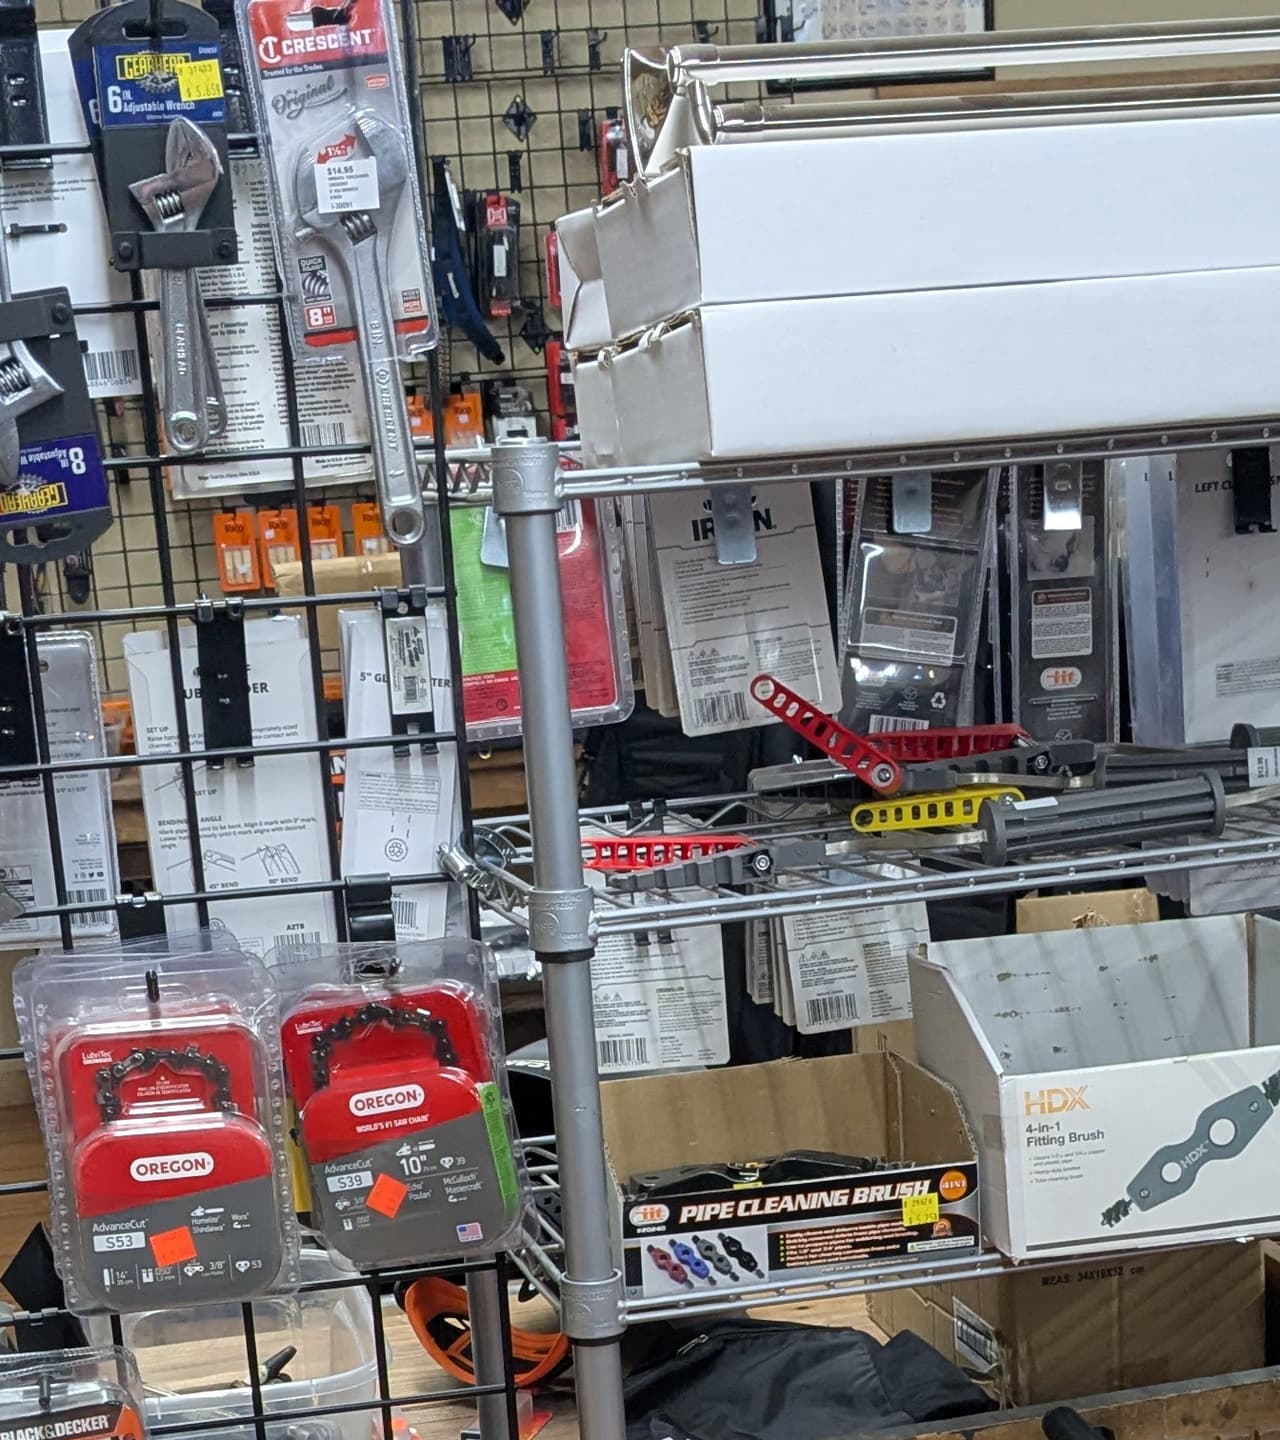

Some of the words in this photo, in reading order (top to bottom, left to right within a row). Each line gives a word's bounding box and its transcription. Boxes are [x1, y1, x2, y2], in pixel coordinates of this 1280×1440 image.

[281, 29, 372, 56] CRESCENT
[124, 55, 186, 79] GEARHEAD
[108, 85, 122, 113] 6
[123, 101, 165, 113] Adjustable
[165, 99, 196, 110] Wrench
[271, 75, 336, 120] Original
[326, 165, 354, 176] $14.95
[28, 448, 68, 465] Adjustable
[69, 446, 87, 475] 8
[1194, 482, 1218, 494] LEFT
[0, 485, 61, 513] GEARHEAD
[200, 814, 223, 823] ANGLE
[354, 1088, 418, 1111] OREGON
[1024, 1085, 1091, 1116] HDX
[1025, 1121, 1061, 1134] 4-in-1
[1027, 1132, 1066, 1147] Fitting
[1069, 1128, 1105, 1143] Brush
[136, 1156, 208, 1176] OREGON
[399, 1155, 428, 1176] 10"
[455, 1156, 467, 1167] 39
[1181, 1143, 1209, 1170] HDX
[324, 1158, 373, 1175] AdvanceCut
[337, 1174, 364, 1190] S39
[679, 1199, 731, 1224] PIPE
[733, 1186, 852, 1219] CLEANING
[854, 1179, 932, 1208] BRUSH
[92, 1218, 148, 1233] AdvanceCut
[105, 1234, 134, 1250] S53
[251, 1259, 263, 1269] 53
